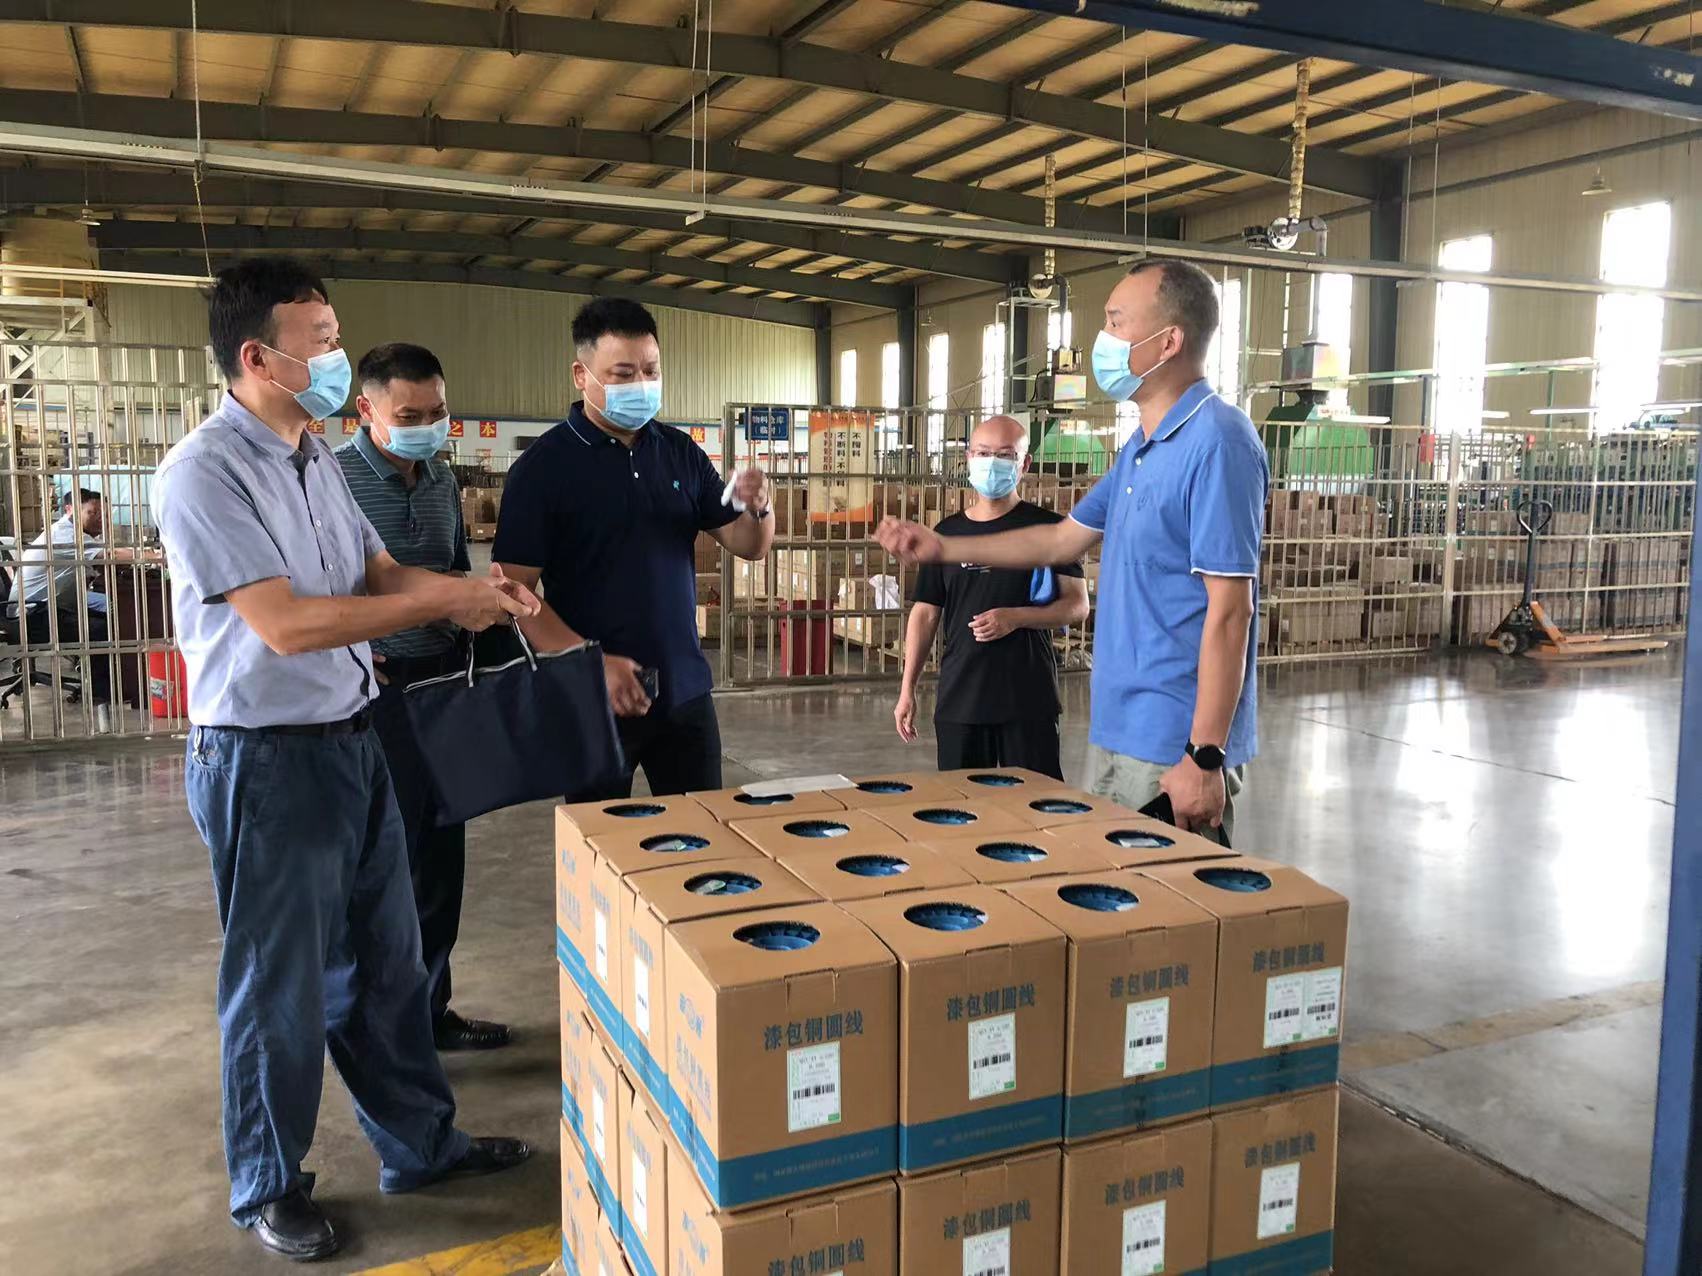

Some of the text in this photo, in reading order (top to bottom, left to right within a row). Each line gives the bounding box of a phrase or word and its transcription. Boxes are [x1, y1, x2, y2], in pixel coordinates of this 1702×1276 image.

[752, 415, 785, 425] 物料仓库
[946, 983, 1036, 1021] 漆包铜圆线
[764, 1008, 865, 1051] 漆包铜圆线
[1104, 1165, 1185, 1207] 漆包铜圆线
[943, 1199, 1032, 1240] 漆包铜圆线
